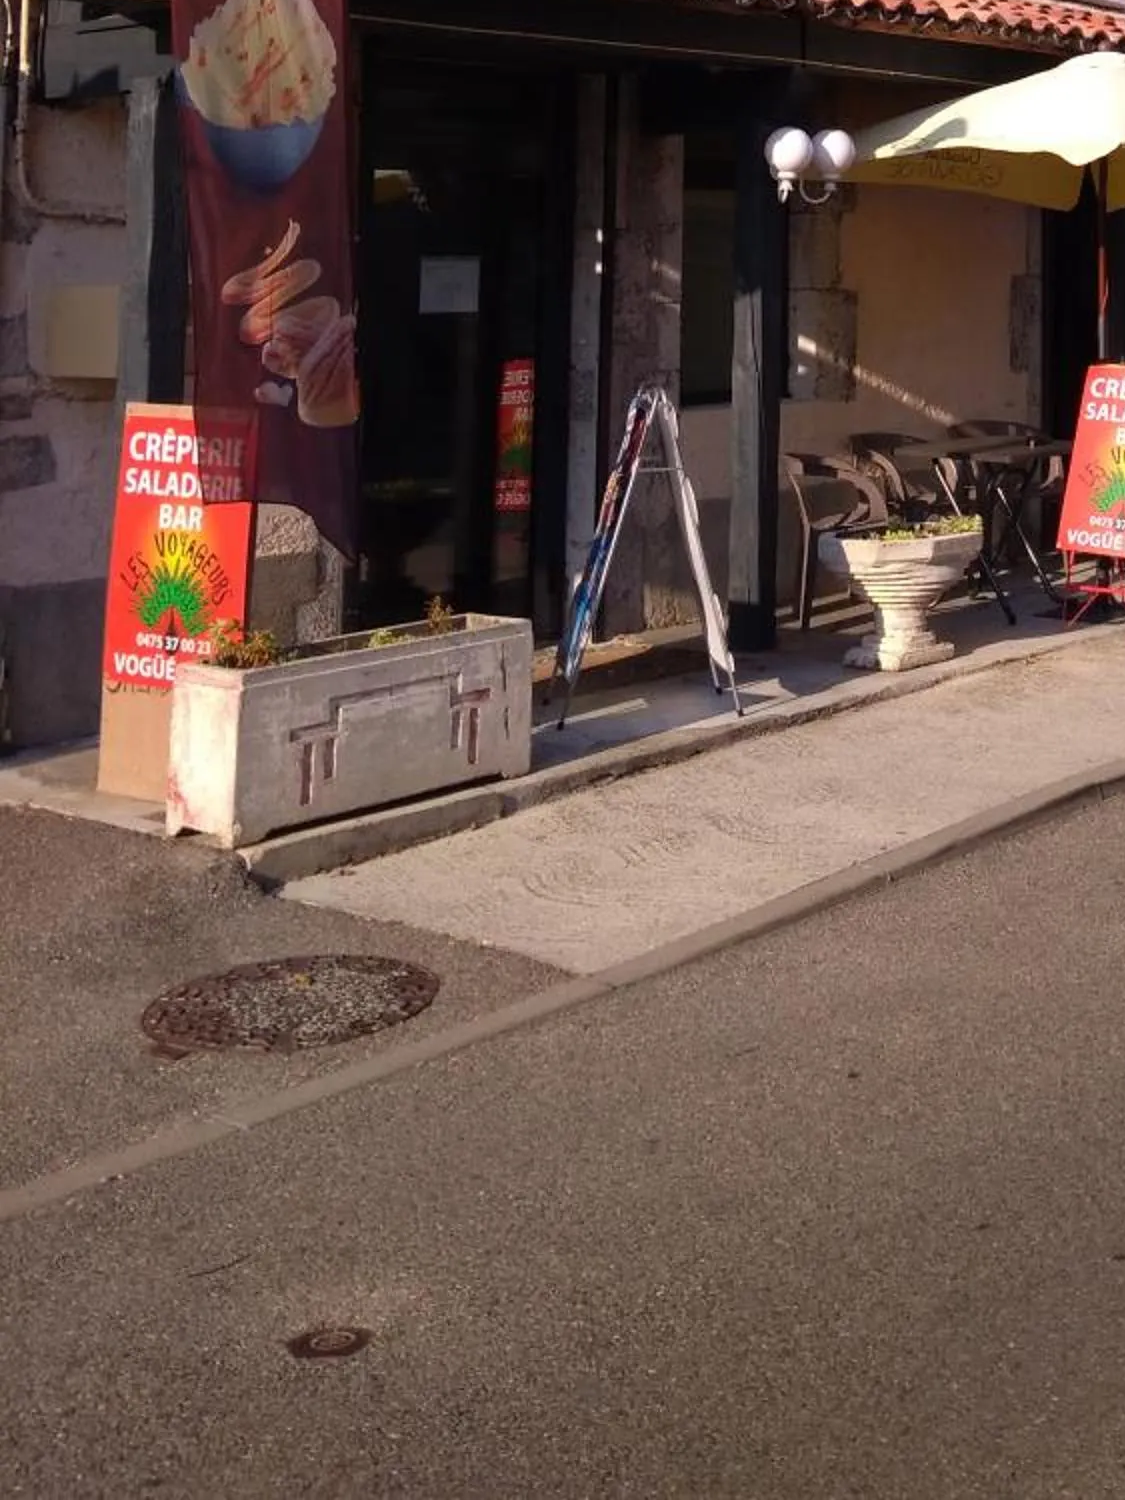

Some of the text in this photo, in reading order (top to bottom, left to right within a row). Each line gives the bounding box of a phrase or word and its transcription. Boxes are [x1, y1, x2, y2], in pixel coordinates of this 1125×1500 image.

[129, 428, 245, 467] CRÊPERIE
[124, 467, 244, 501] SALADERIE
[159, 503, 204, 532] BAR
[120, 532, 234, 607] LES VOYAGEURS
[136, 632, 164, 649] 0475
[165, 636, 179, 651] 37
[180, 638, 196, 653] 00
